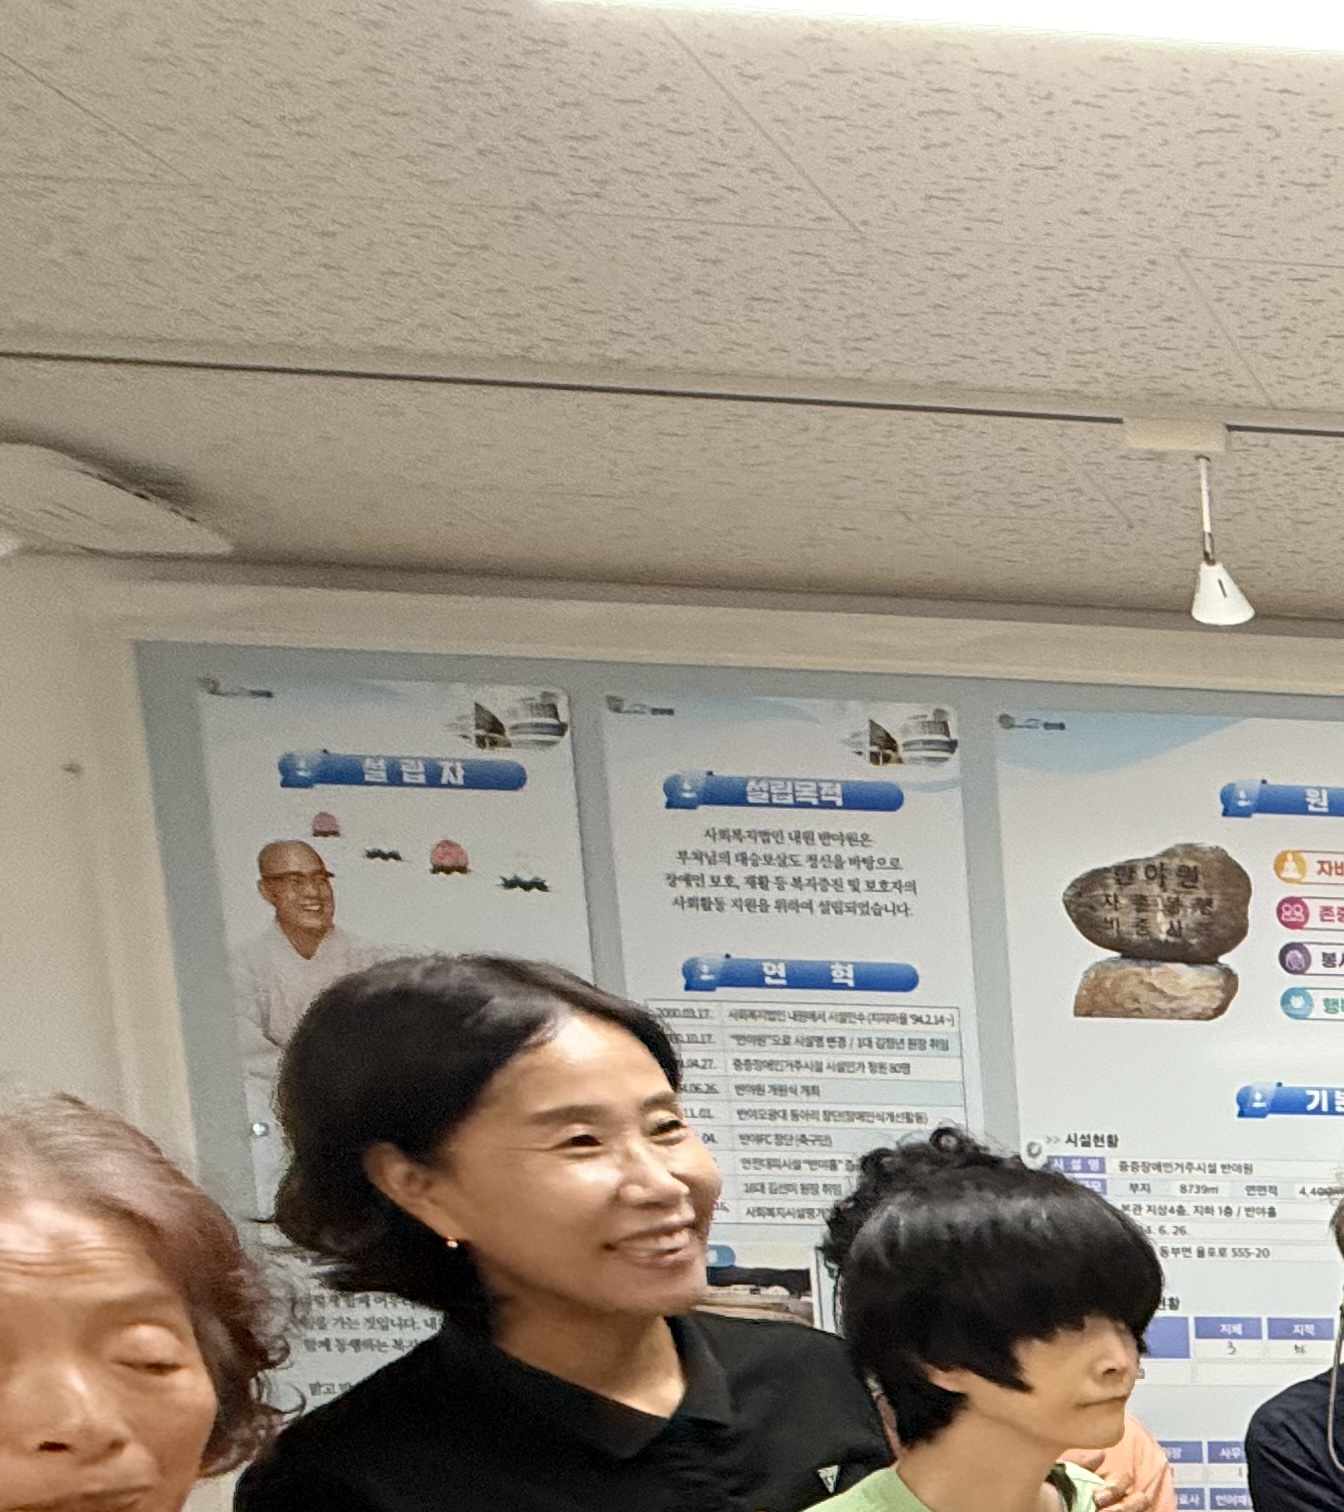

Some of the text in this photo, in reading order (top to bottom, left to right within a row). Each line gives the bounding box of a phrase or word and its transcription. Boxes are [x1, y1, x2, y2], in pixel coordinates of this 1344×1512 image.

[746, 780, 843, 806] 설립목적
[704, 827, 784, 843] 사회복지법인
[819, 832, 872, 846] 반야원은
[676, 850, 731, 865] 부처님의
[848, 856, 903, 870] 바탕으로
[666, 873, 705, 887] 장애인
[865, 879, 917, 895] 보호자의
[673, 896, 726, 912] 사회활동
[731, 898, 771, 913] 지원을
[774, 899, 813, 914] 위하여
[1065, 1133, 1119, 1148] 시설현황
[1221, 1161, 1253, 1175] 반야원
[1129, 1183, 1151, 1194] 부지
[1245, 1185, 1278, 1196] 연면적
[1193, 1205, 1215, 1217] 지하
[1231, 1247, 1270, 1258] 555-20
